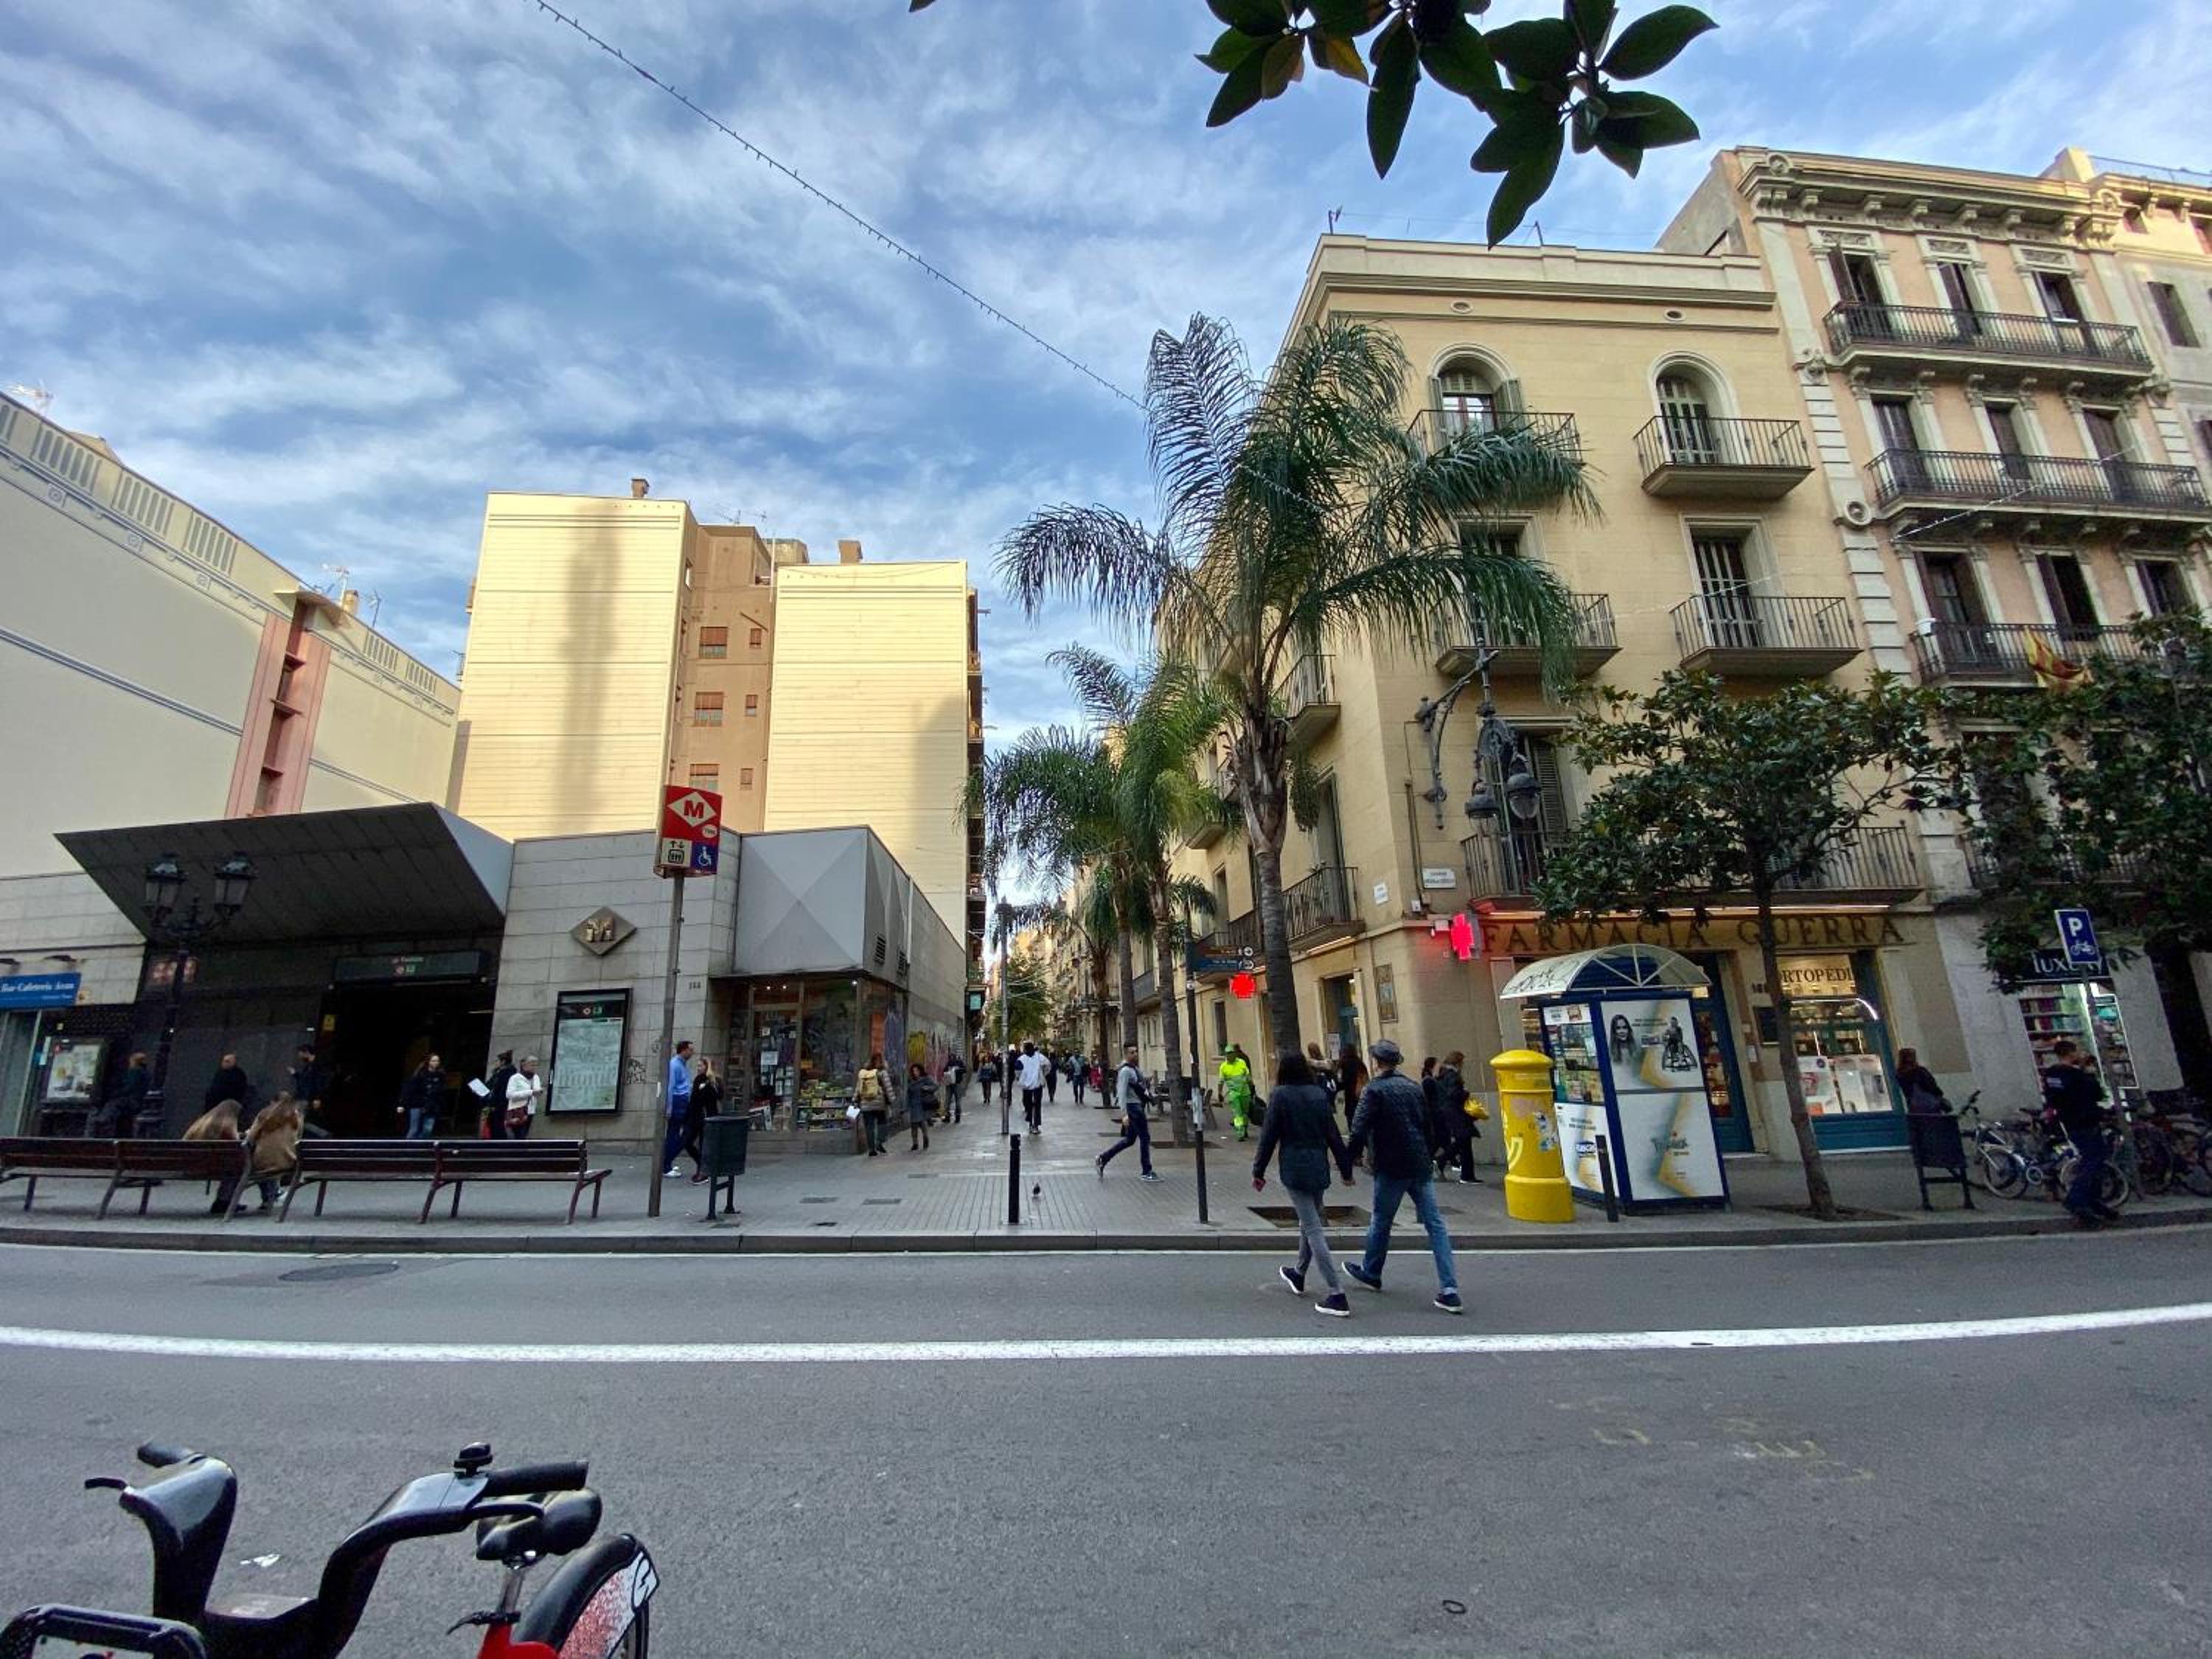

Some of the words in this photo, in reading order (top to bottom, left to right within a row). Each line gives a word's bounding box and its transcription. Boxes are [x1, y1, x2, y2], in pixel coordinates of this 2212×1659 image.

[684, 800, 704, 818] M
[1483, 919, 1711, 953] FARMACIA
[2067, 917, 2083, 937] P
[1780, 967, 1853, 984] RTOPEDI
